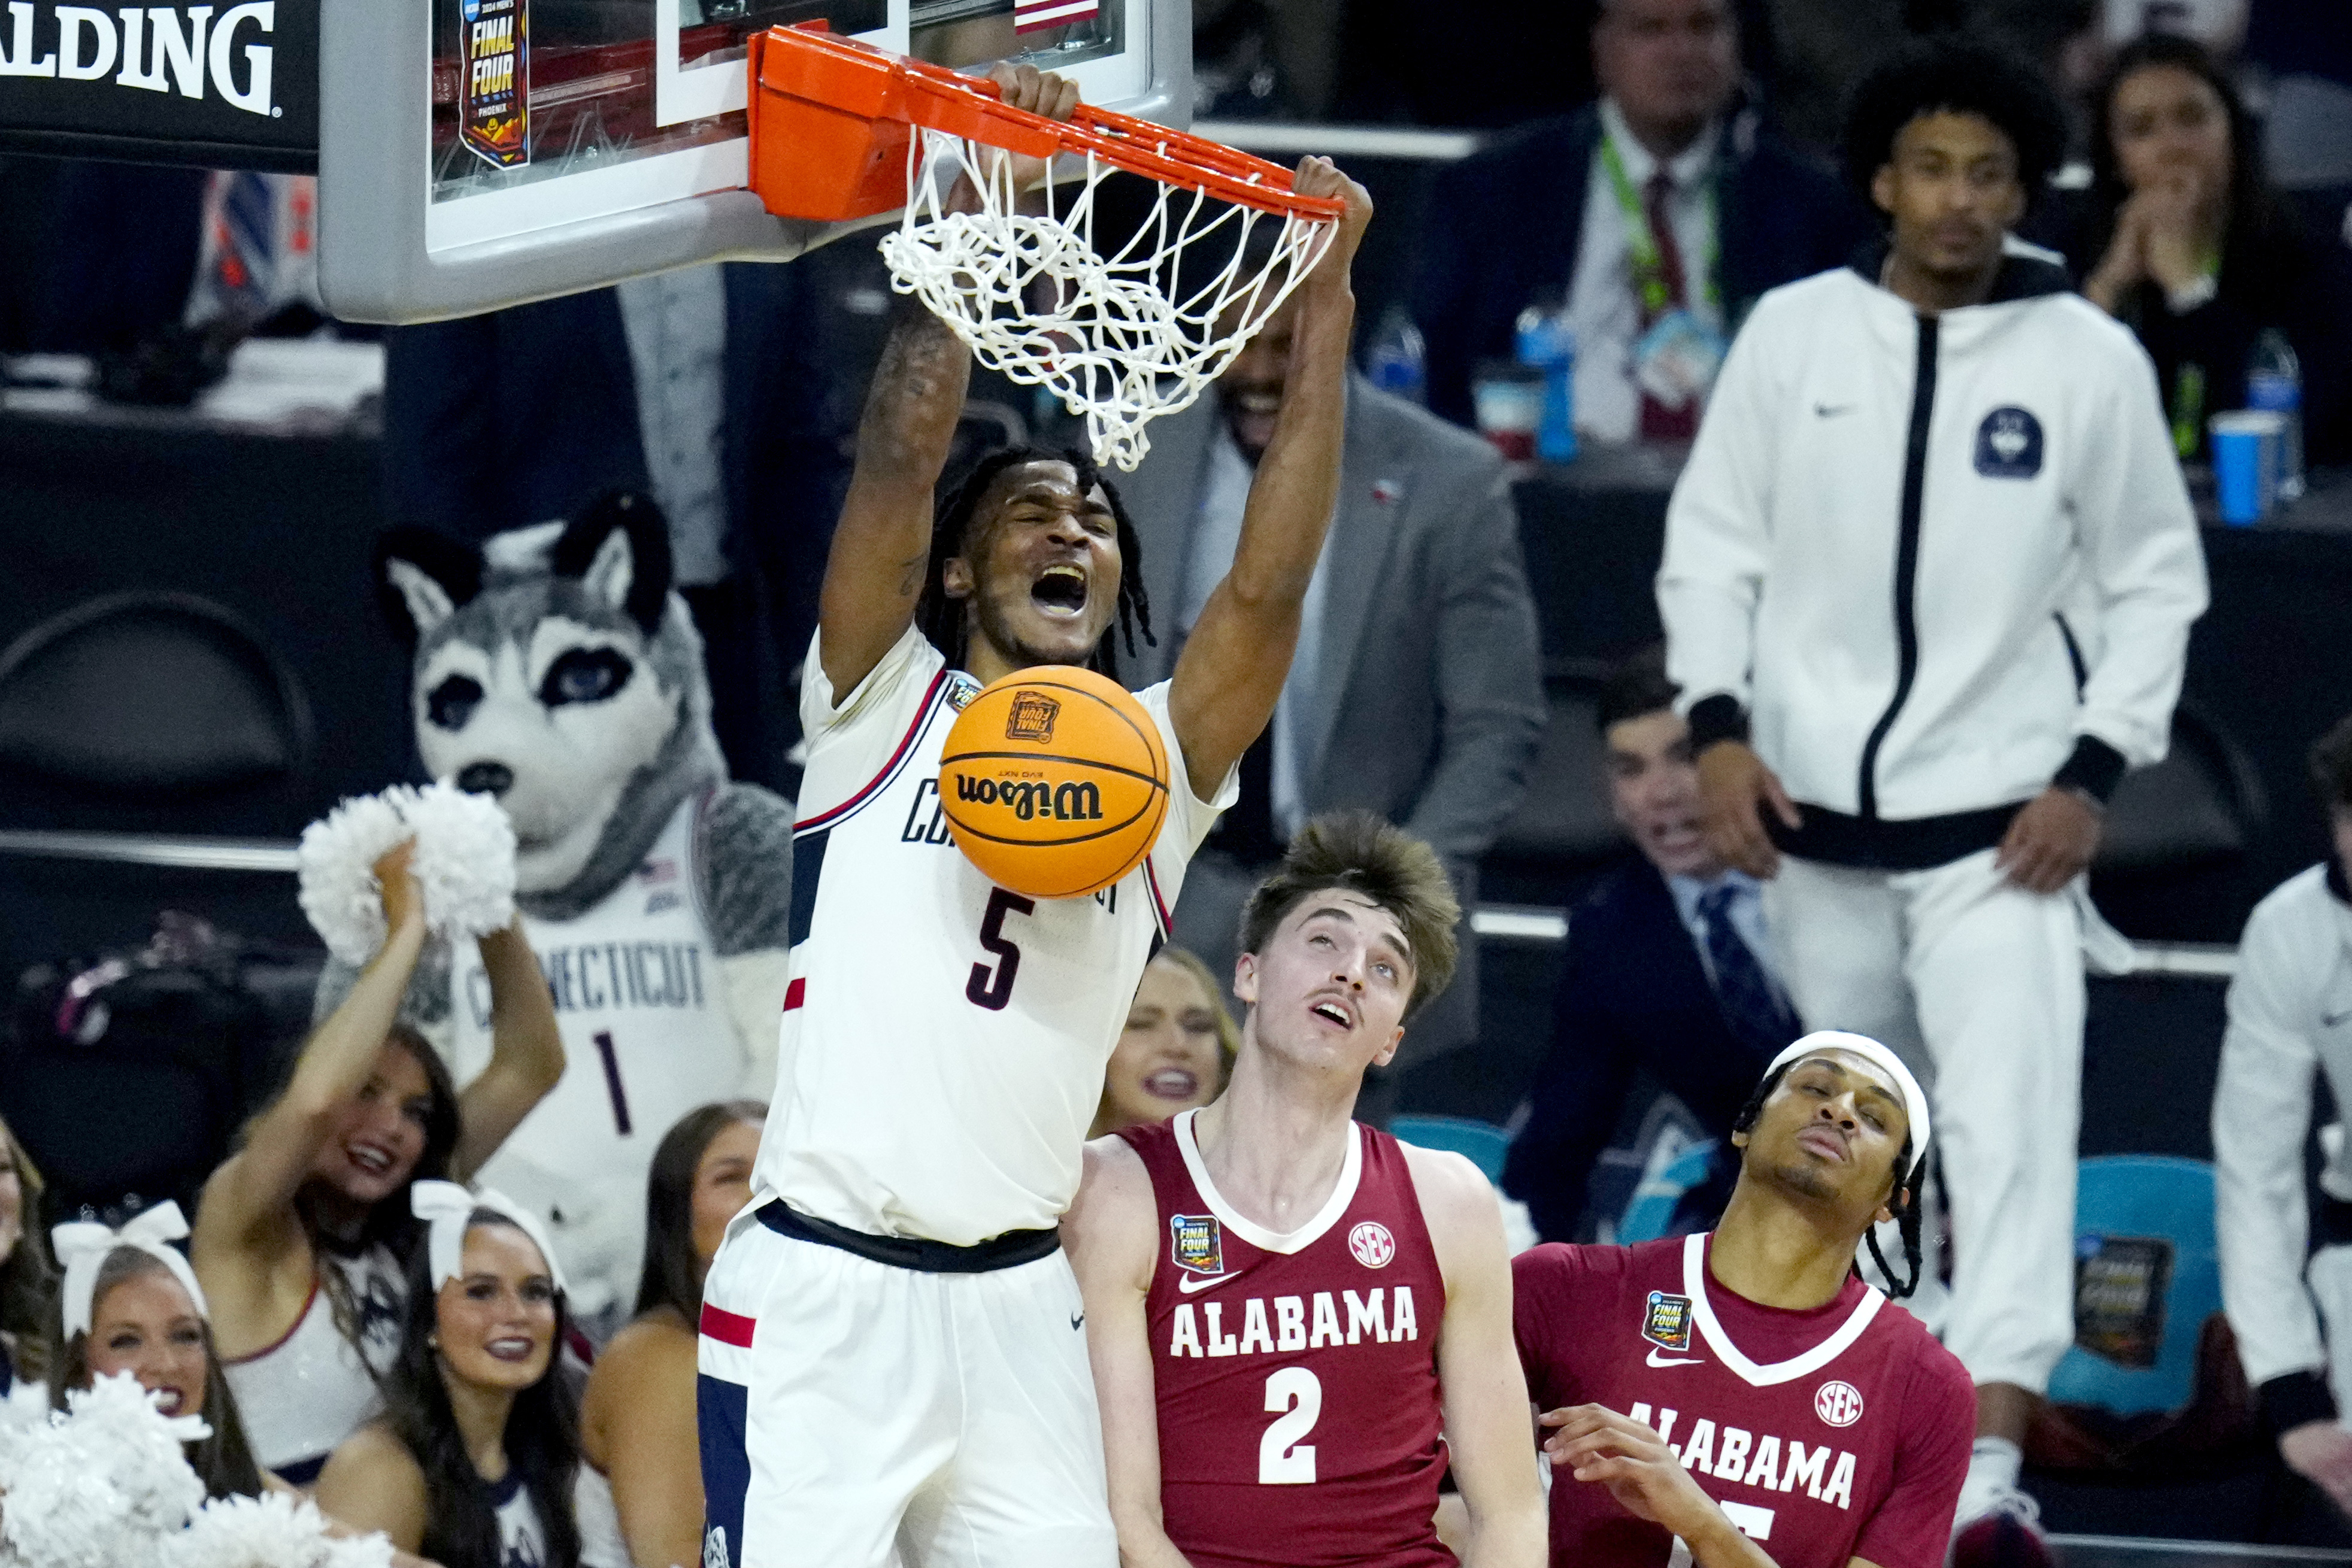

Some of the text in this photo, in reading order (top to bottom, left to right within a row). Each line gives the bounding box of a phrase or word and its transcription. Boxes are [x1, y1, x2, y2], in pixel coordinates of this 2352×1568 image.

[0, 1, 275, 116] LDING
[471, 15, 514, 59] FINAL
[471, 54, 514, 98] FOUR
[478, 102, 507, 117] PHOENIX
[1016, 719, 1048, 732] FINAL
[1019, 708, 1051, 720] FOUR
[956, 774, 1104, 821] Wilson
[966, 886, 1035, 1011] 5
[466, 942, 706, 1031] CNECTICUT
[593, 1031, 632, 1136] 1
[1180, 1227, 1209, 1240] FINAL
[1180, 1238, 1210, 1251] FOUR
[1352, 1224, 1392, 1266] SEC
[1170, 1286, 1418, 1358] ALABAMA
[1652, 1314, 1681, 1327] FOUR
[1653, 1305, 1683, 1317] FINAL
[1818, 1383, 1859, 1423] SEC
[1259, 1366, 1322, 1484] 2
